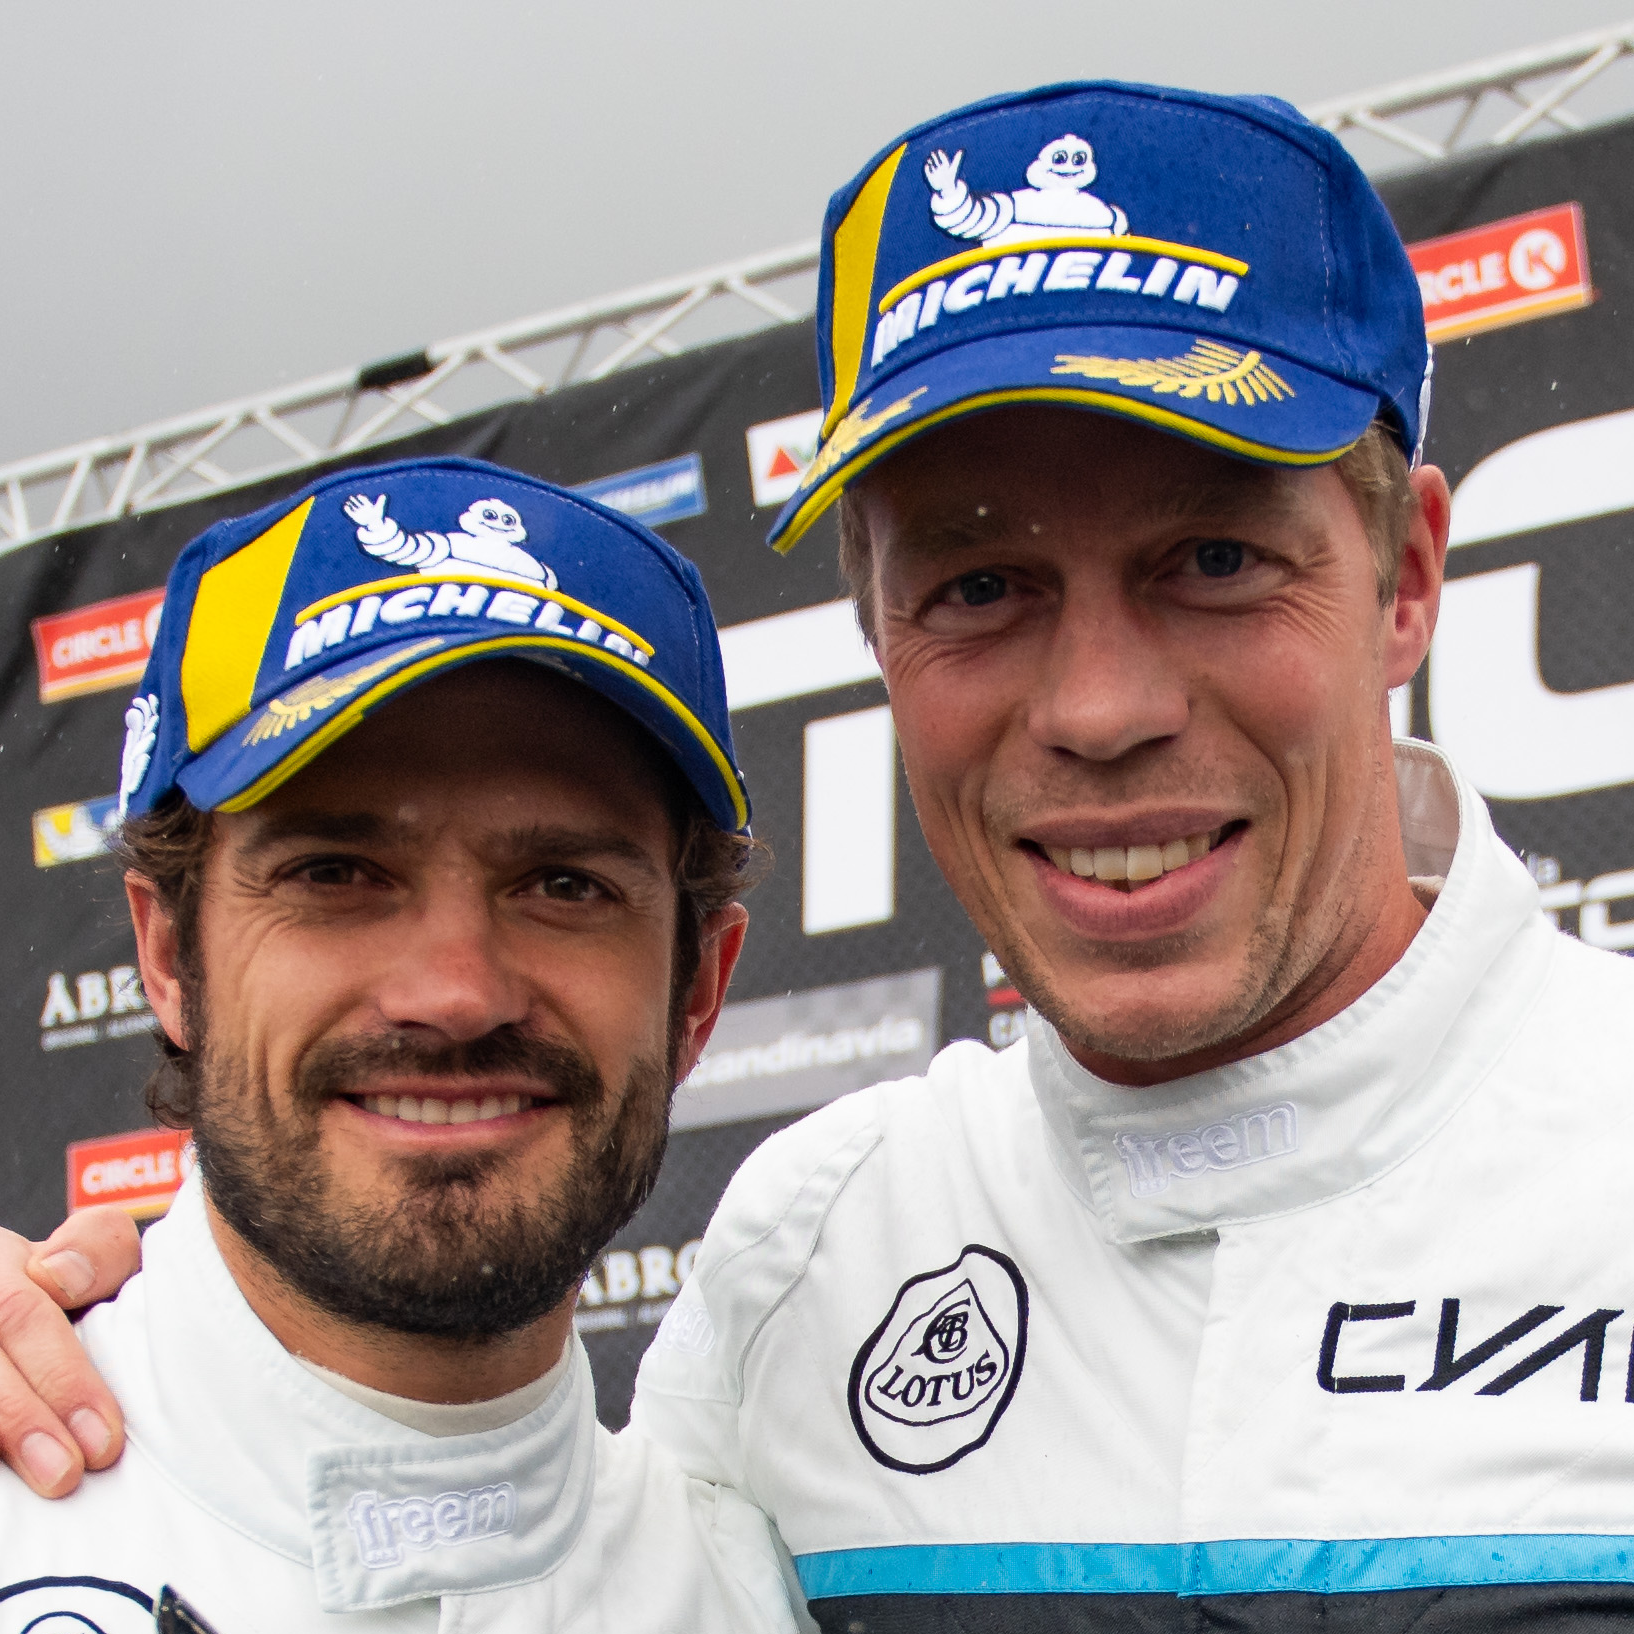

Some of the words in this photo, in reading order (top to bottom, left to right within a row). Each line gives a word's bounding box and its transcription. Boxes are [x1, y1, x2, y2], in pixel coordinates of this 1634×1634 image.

[1417, 251, 1507, 306] RCLE
[1509, 229, 1568, 290] K
[871, 251, 1239, 370] MICHELIN
[52, 618, 142, 669] CIRCLE
[284, 583, 651, 670] MICHELIN
[39, 964, 150, 1029] ÅBR
[81, 1150, 177, 1196] CIRCLE
[1113, 1100, 1298, 1199] freem
[877, 1351, 999, 1410] LOTUS
[347, 1481, 517, 1570] freem
